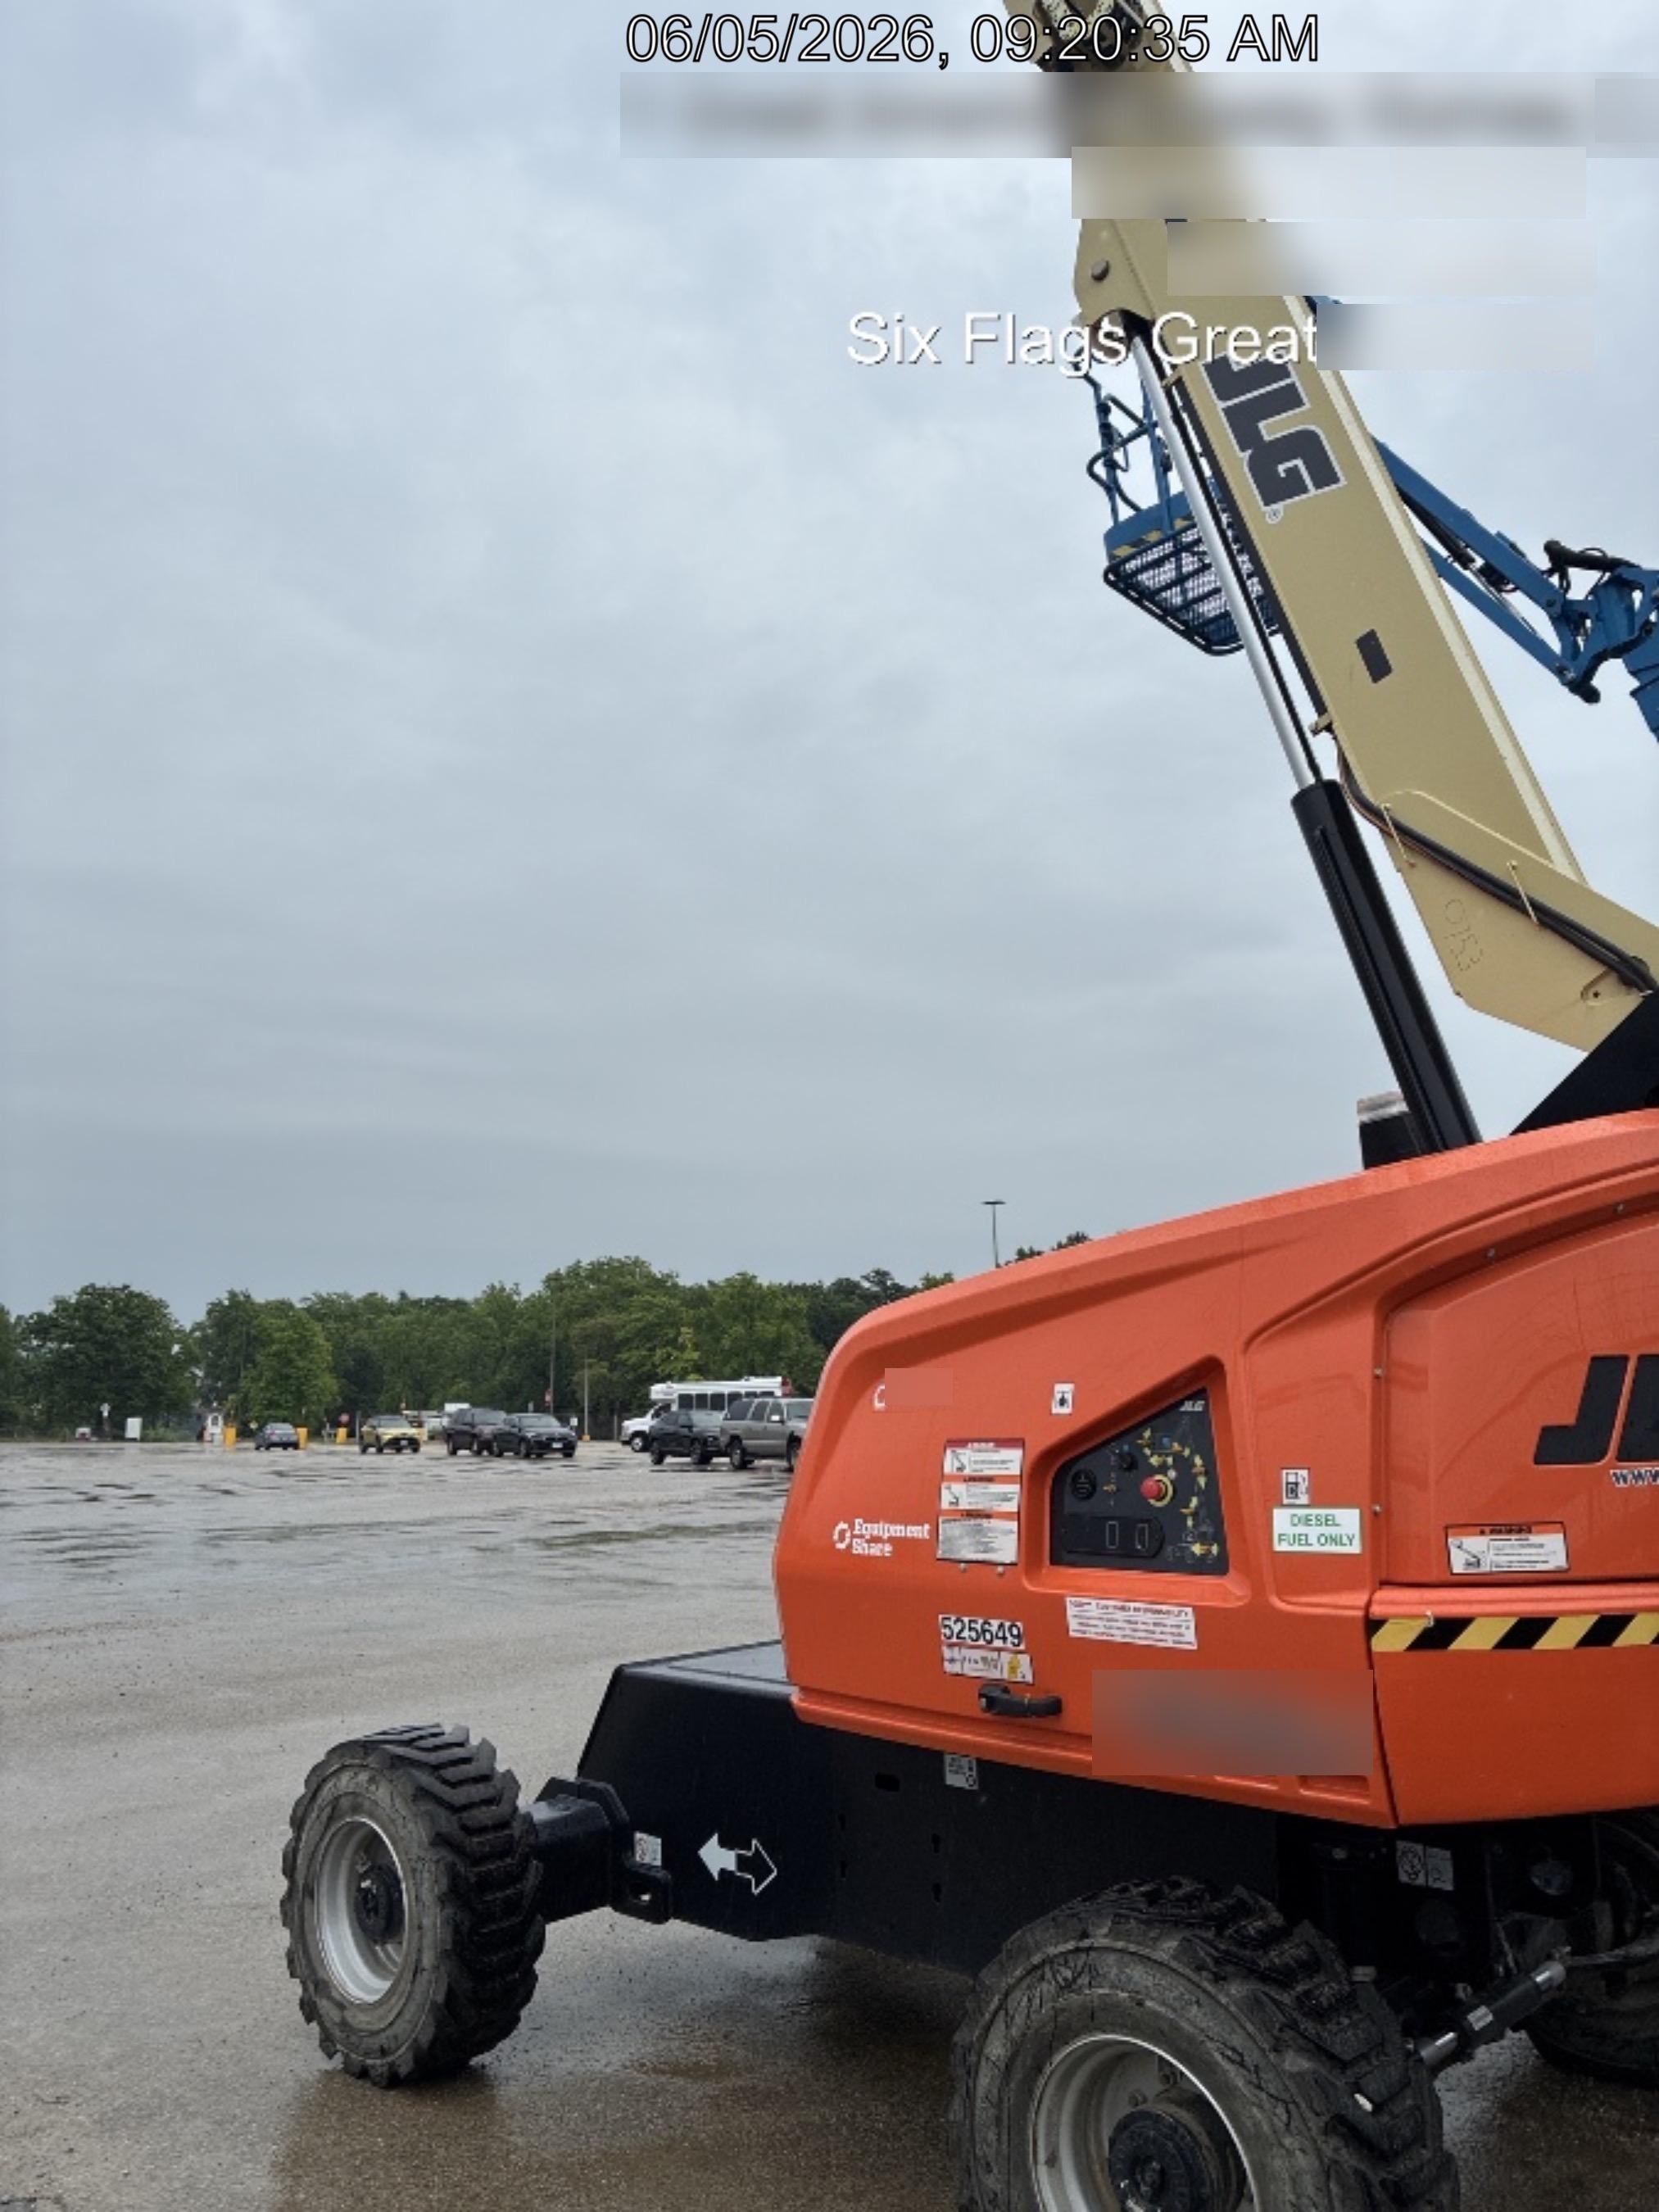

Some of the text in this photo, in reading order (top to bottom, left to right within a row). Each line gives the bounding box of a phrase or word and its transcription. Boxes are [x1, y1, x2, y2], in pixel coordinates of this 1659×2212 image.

[853, 1518, 930, 1539] Equipment
[1290, 1513, 1341, 1527] DIESEL
[852, 1539, 892, 1556] Share
[1278, 1533, 1355, 1547] FUEL ONLY
[941, 1616, 1022, 1648] 525649
